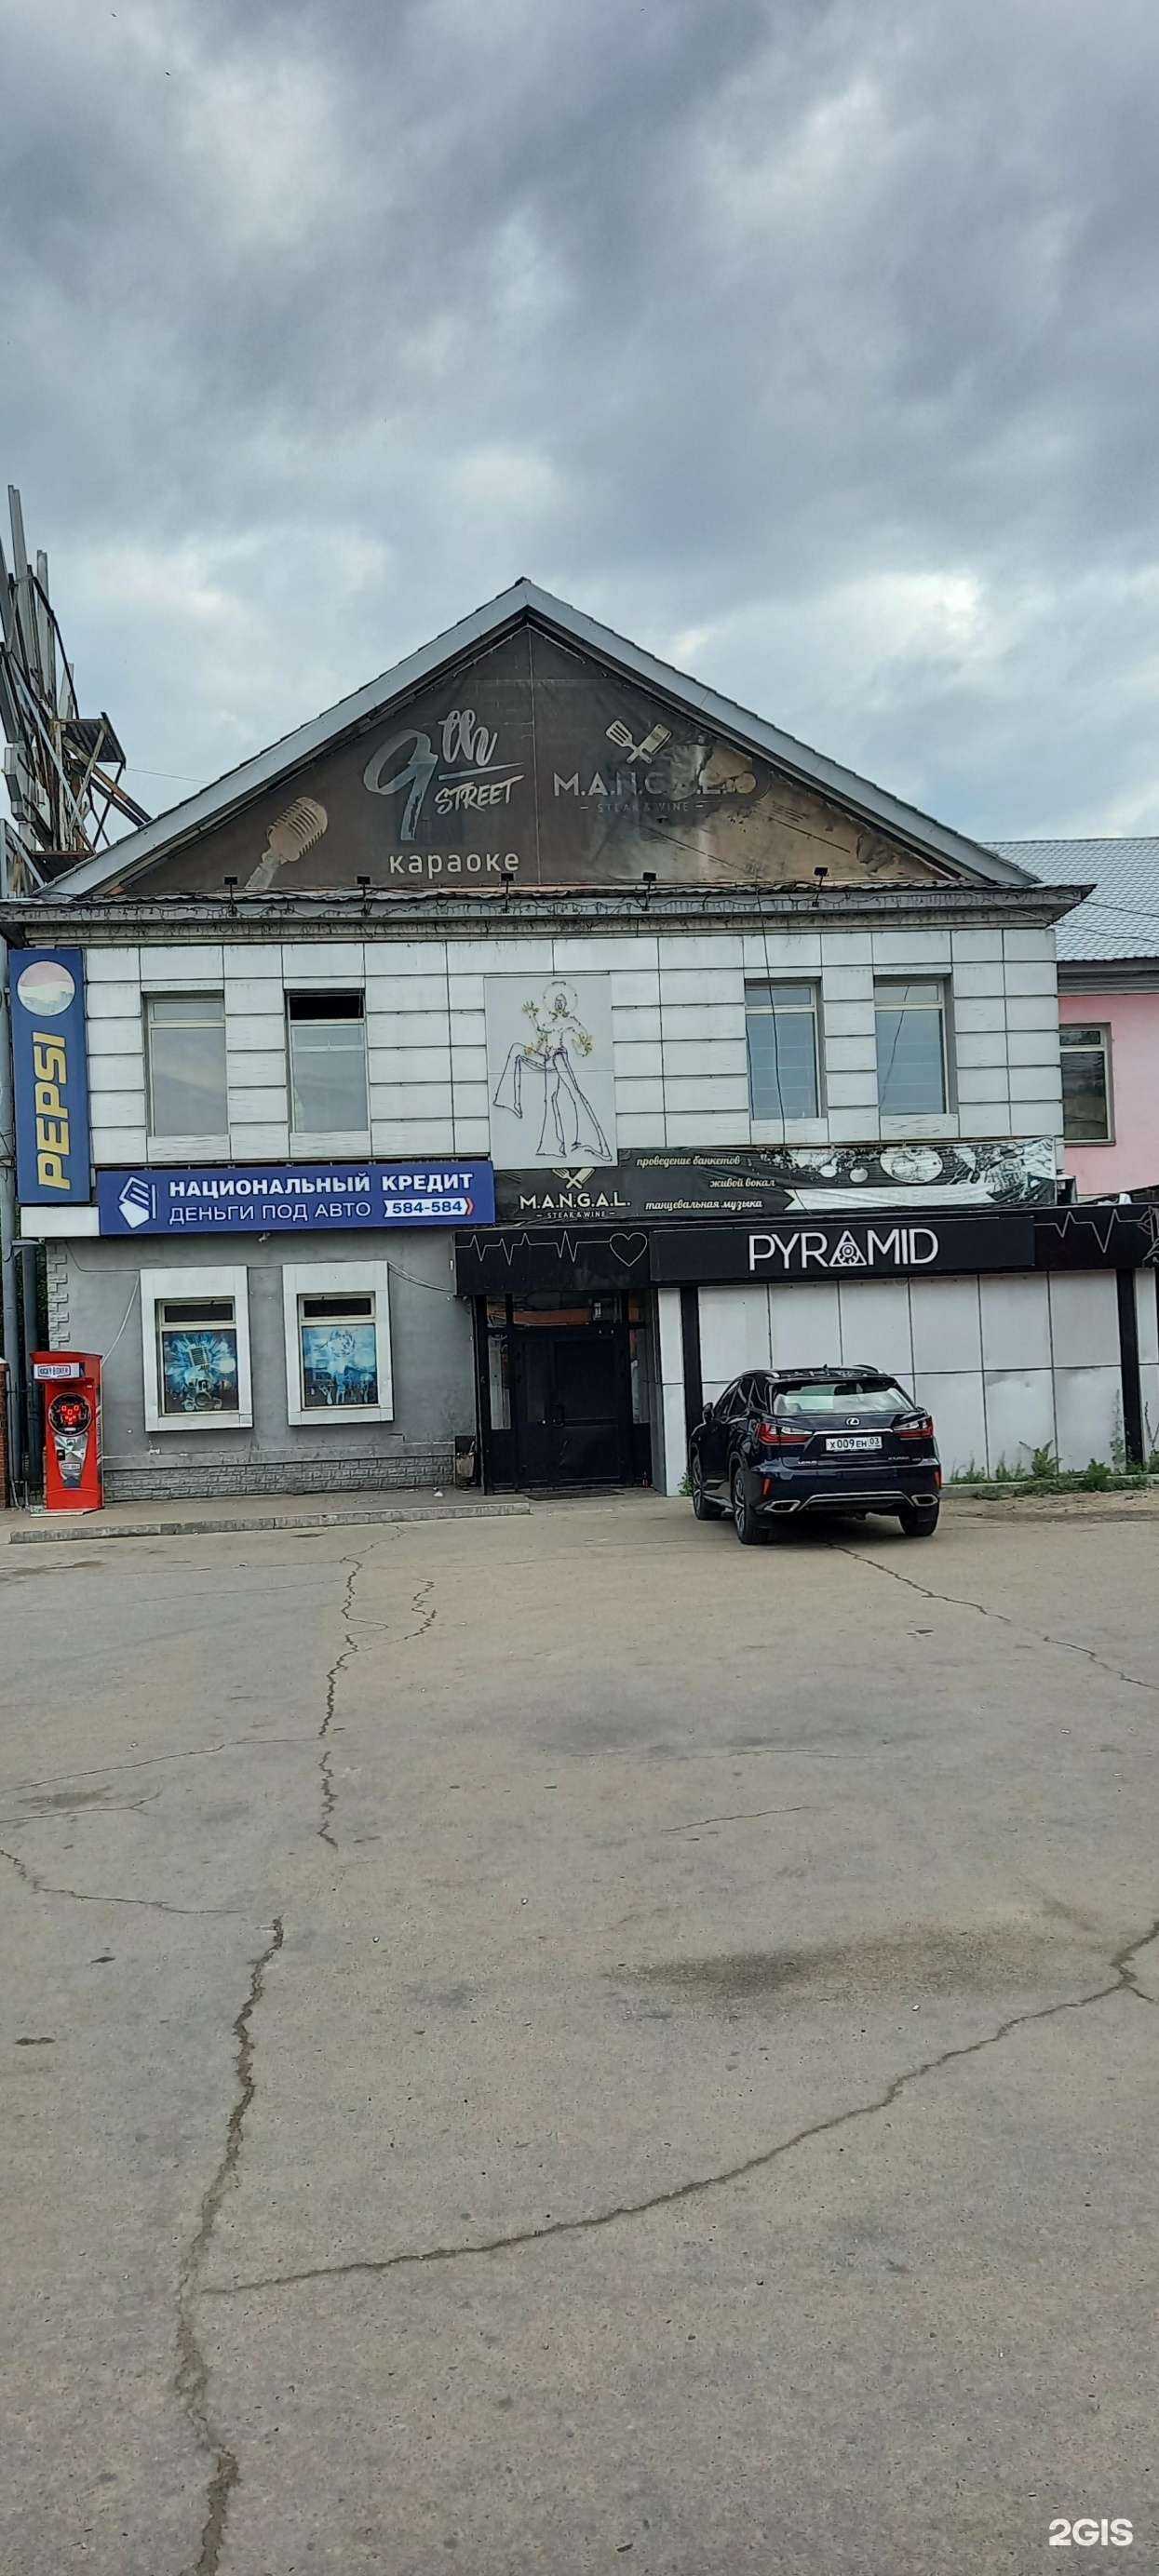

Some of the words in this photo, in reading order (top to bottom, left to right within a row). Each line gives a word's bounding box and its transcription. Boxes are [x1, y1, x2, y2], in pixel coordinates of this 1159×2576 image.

[435, 774, 525, 815] STREET
[389, 852, 519, 879] караоке
[33, 1031, 71, 1189] PEPSI
[637, 1155, 691, 1168] проведение
[693, 1155, 740, 1165] банкетов
[168, 1172, 371, 1199] НАЦИОНАЛЬНЫЙ
[382, 1174, 473, 1193] КРЕДИТ
[710, 1178, 744, 1188] живой
[746, 1177, 775, 1187] вокал
[392, 1201, 463, 1214] 584-584
[519, 1192, 631, 1210] M.A.N.G.A.L.
[645, 1200, 719, 1212] танцевальная
[721, 1200, 762, 1211] музыка
[168, 1205, 254, 1225] ДЕНЬГИ
[263, 1203, 308, 1221] ПОД
[315, 1201, 371, 1218] АВТО
[748, 1228, 939, 1271] PYRAMID
[869, 1437, 880, 1445] 03
